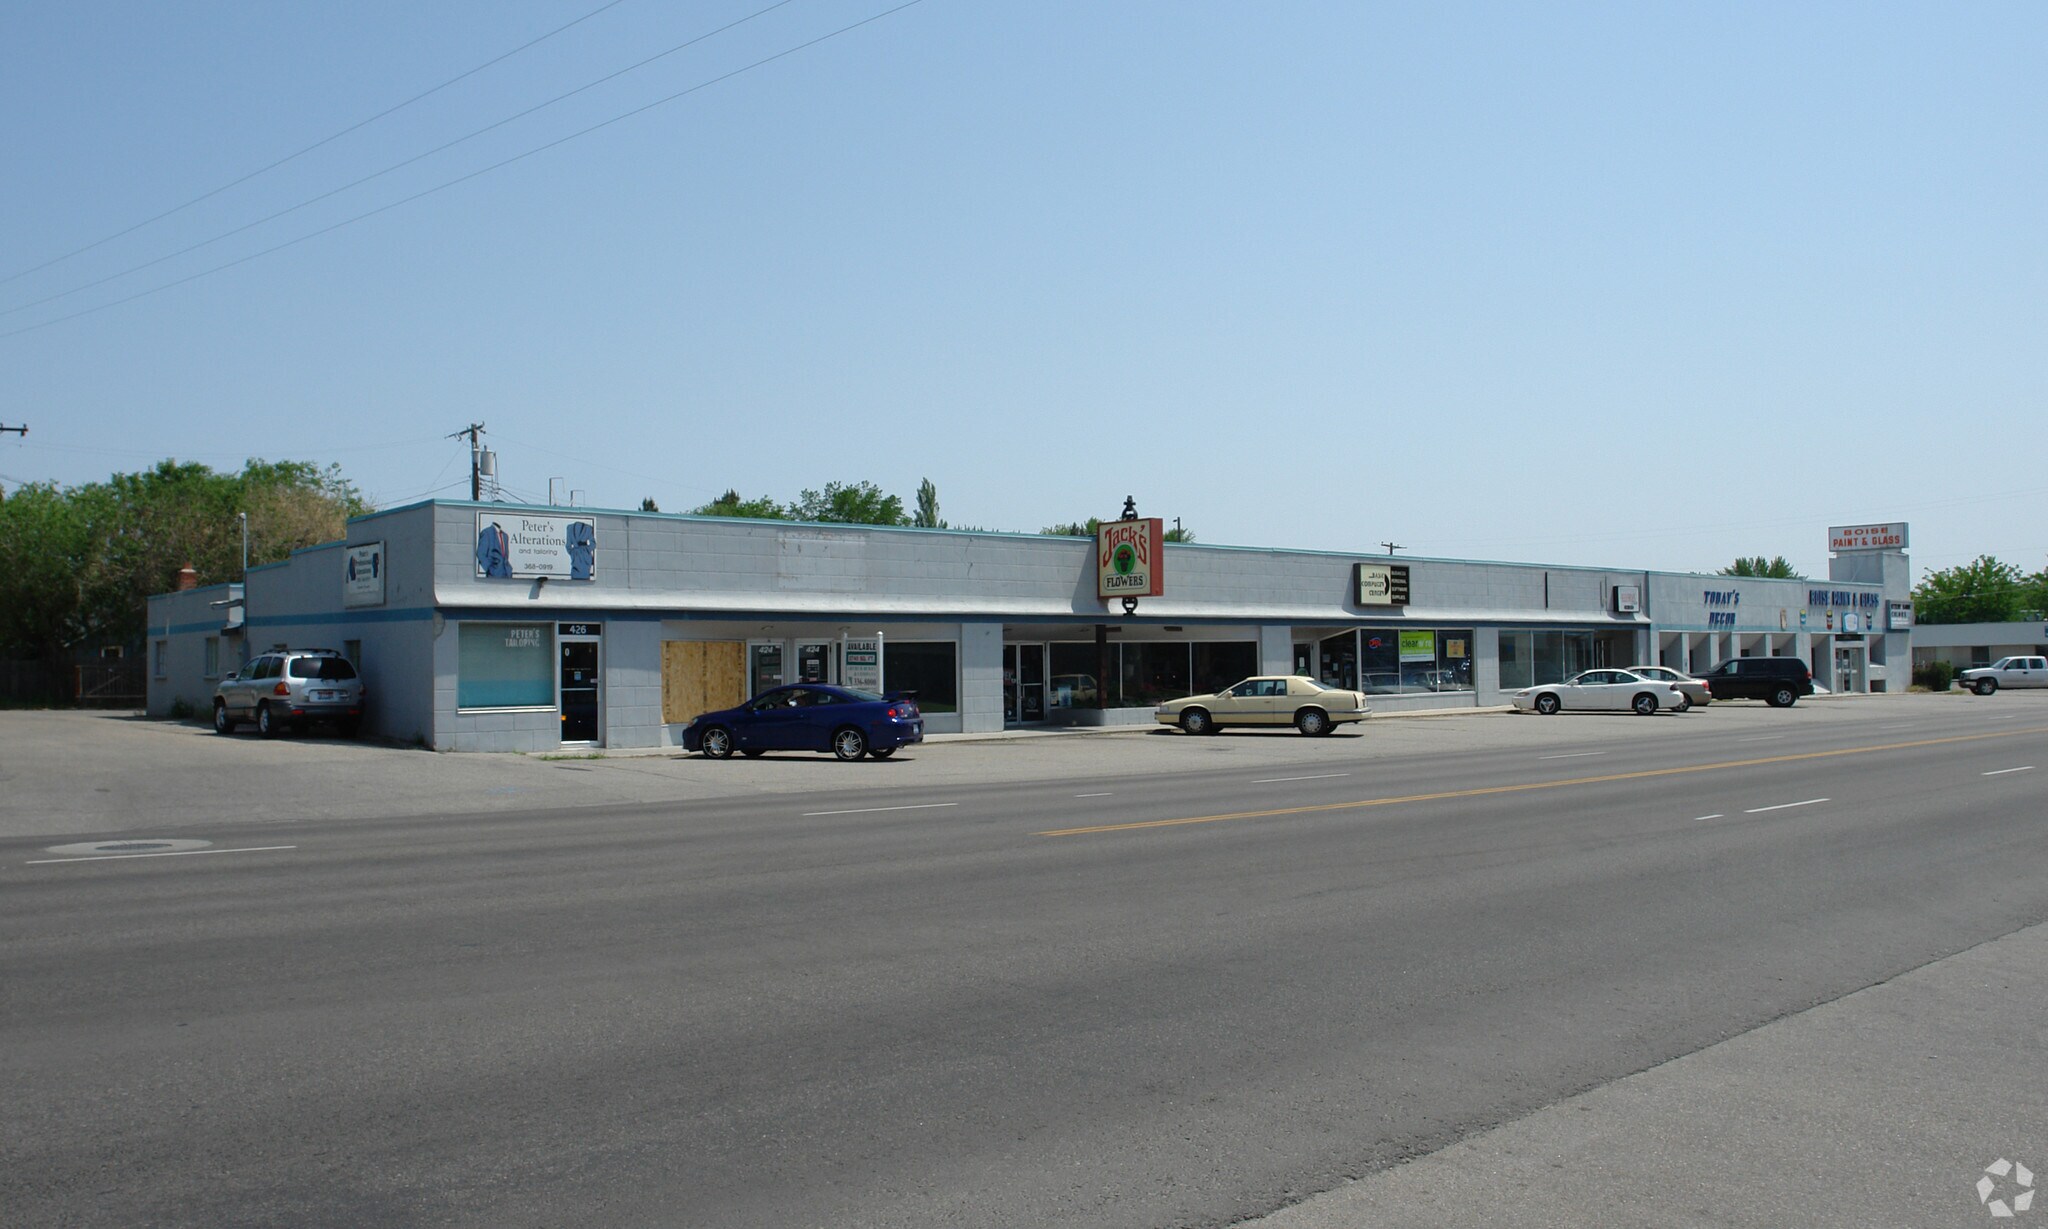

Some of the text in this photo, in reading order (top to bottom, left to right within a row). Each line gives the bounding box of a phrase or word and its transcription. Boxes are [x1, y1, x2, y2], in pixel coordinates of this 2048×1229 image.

[522, 519, 554, 532] Peter's
[510, 533, 566, 546] Alterations
[1833, 534, 1900, 547] PAINT & GLASS
[533, 548, 558, 556] tailoring
[1106, 575, 1144, 587] FLOWERS
[1704, 589, 1740, 605] TODAY'S
[569, 625, 587, 634] 426
